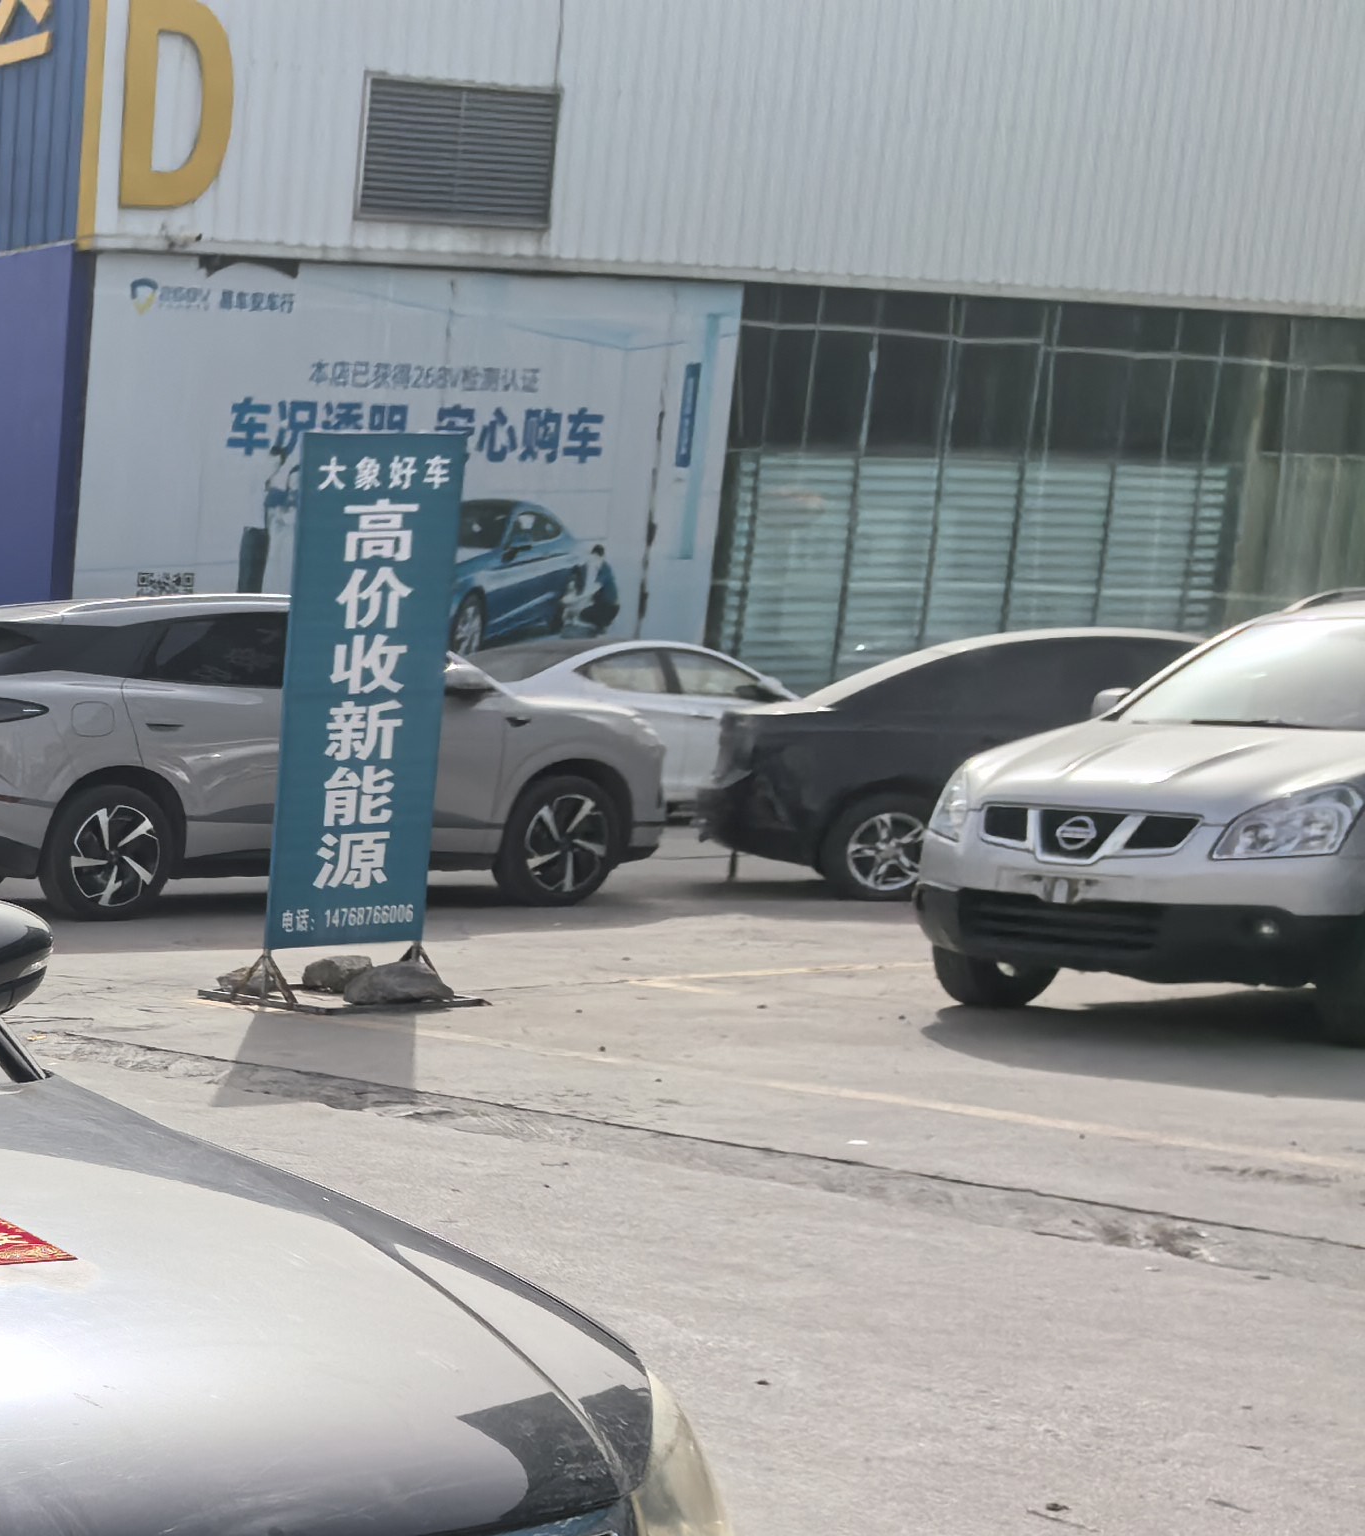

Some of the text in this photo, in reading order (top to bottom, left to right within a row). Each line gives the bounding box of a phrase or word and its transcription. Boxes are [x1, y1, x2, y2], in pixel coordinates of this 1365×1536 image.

[118, 0, 233, 208] D
[318, 456, 451, 492] 大象好车
[313, 498, 420, 890] 高价收新能源
